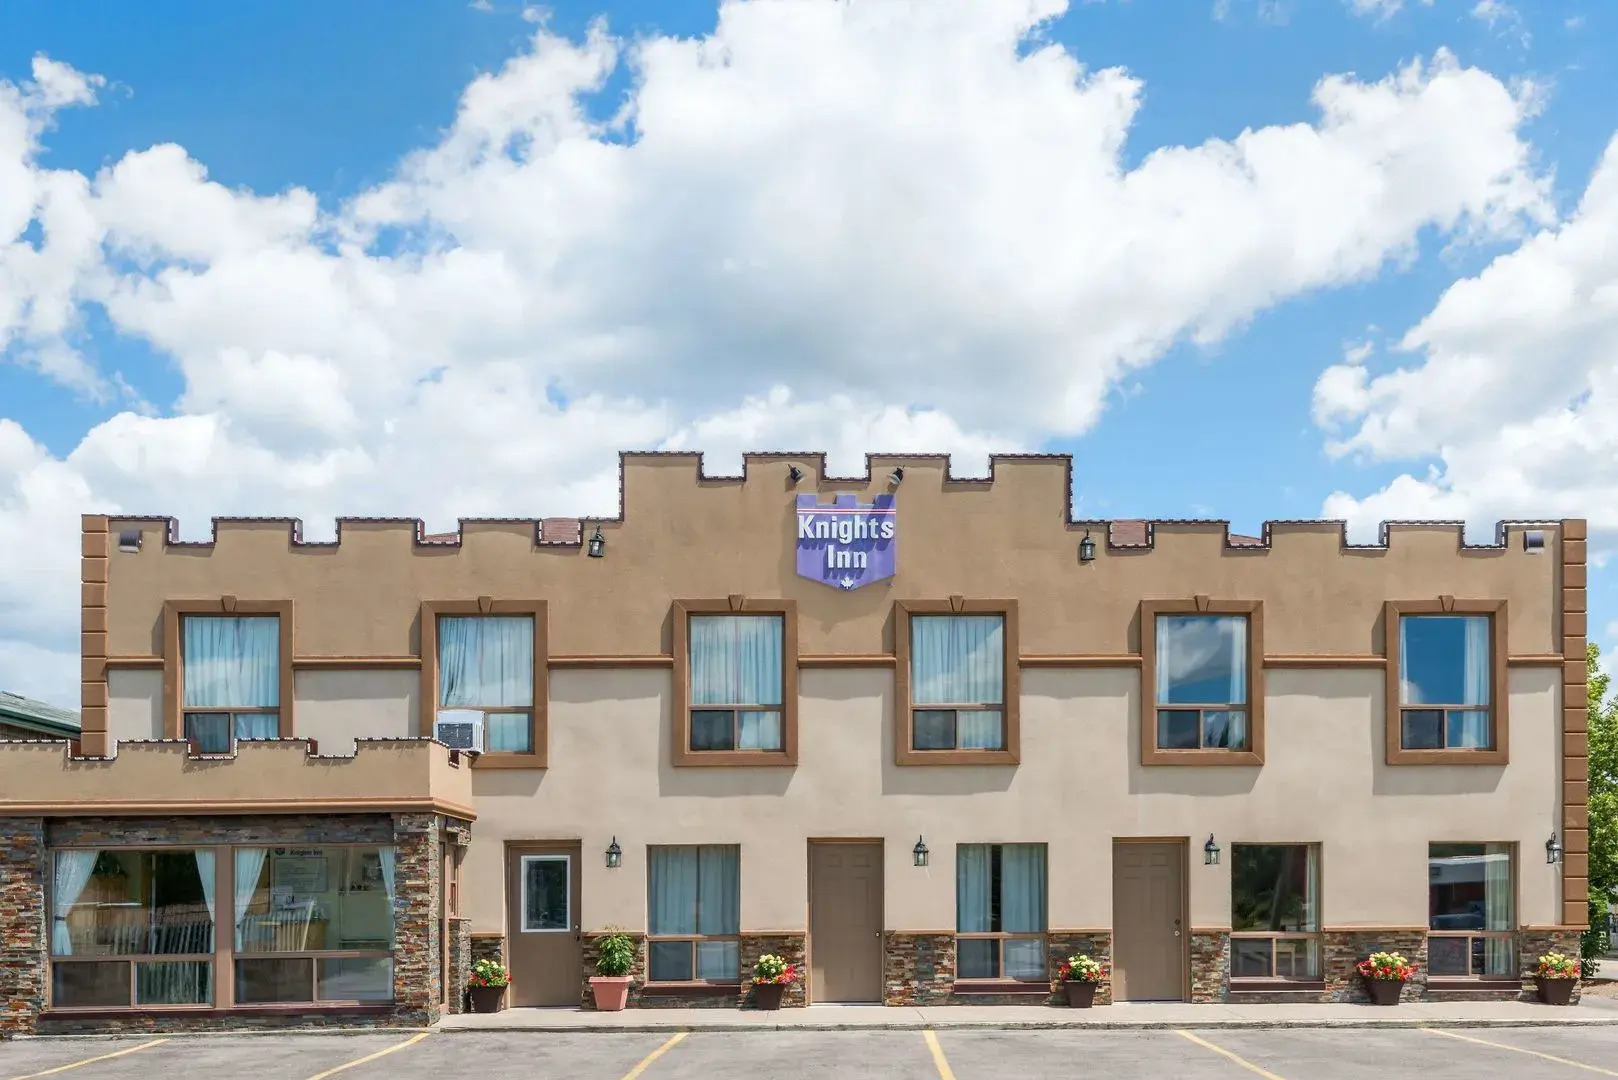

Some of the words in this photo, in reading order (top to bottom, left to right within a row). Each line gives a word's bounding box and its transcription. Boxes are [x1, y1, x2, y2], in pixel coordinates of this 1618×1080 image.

[798, 515, 894, 544] Knights
[827, 545, 867, 568] Inn
[290, 849, 313, 857] Knig
